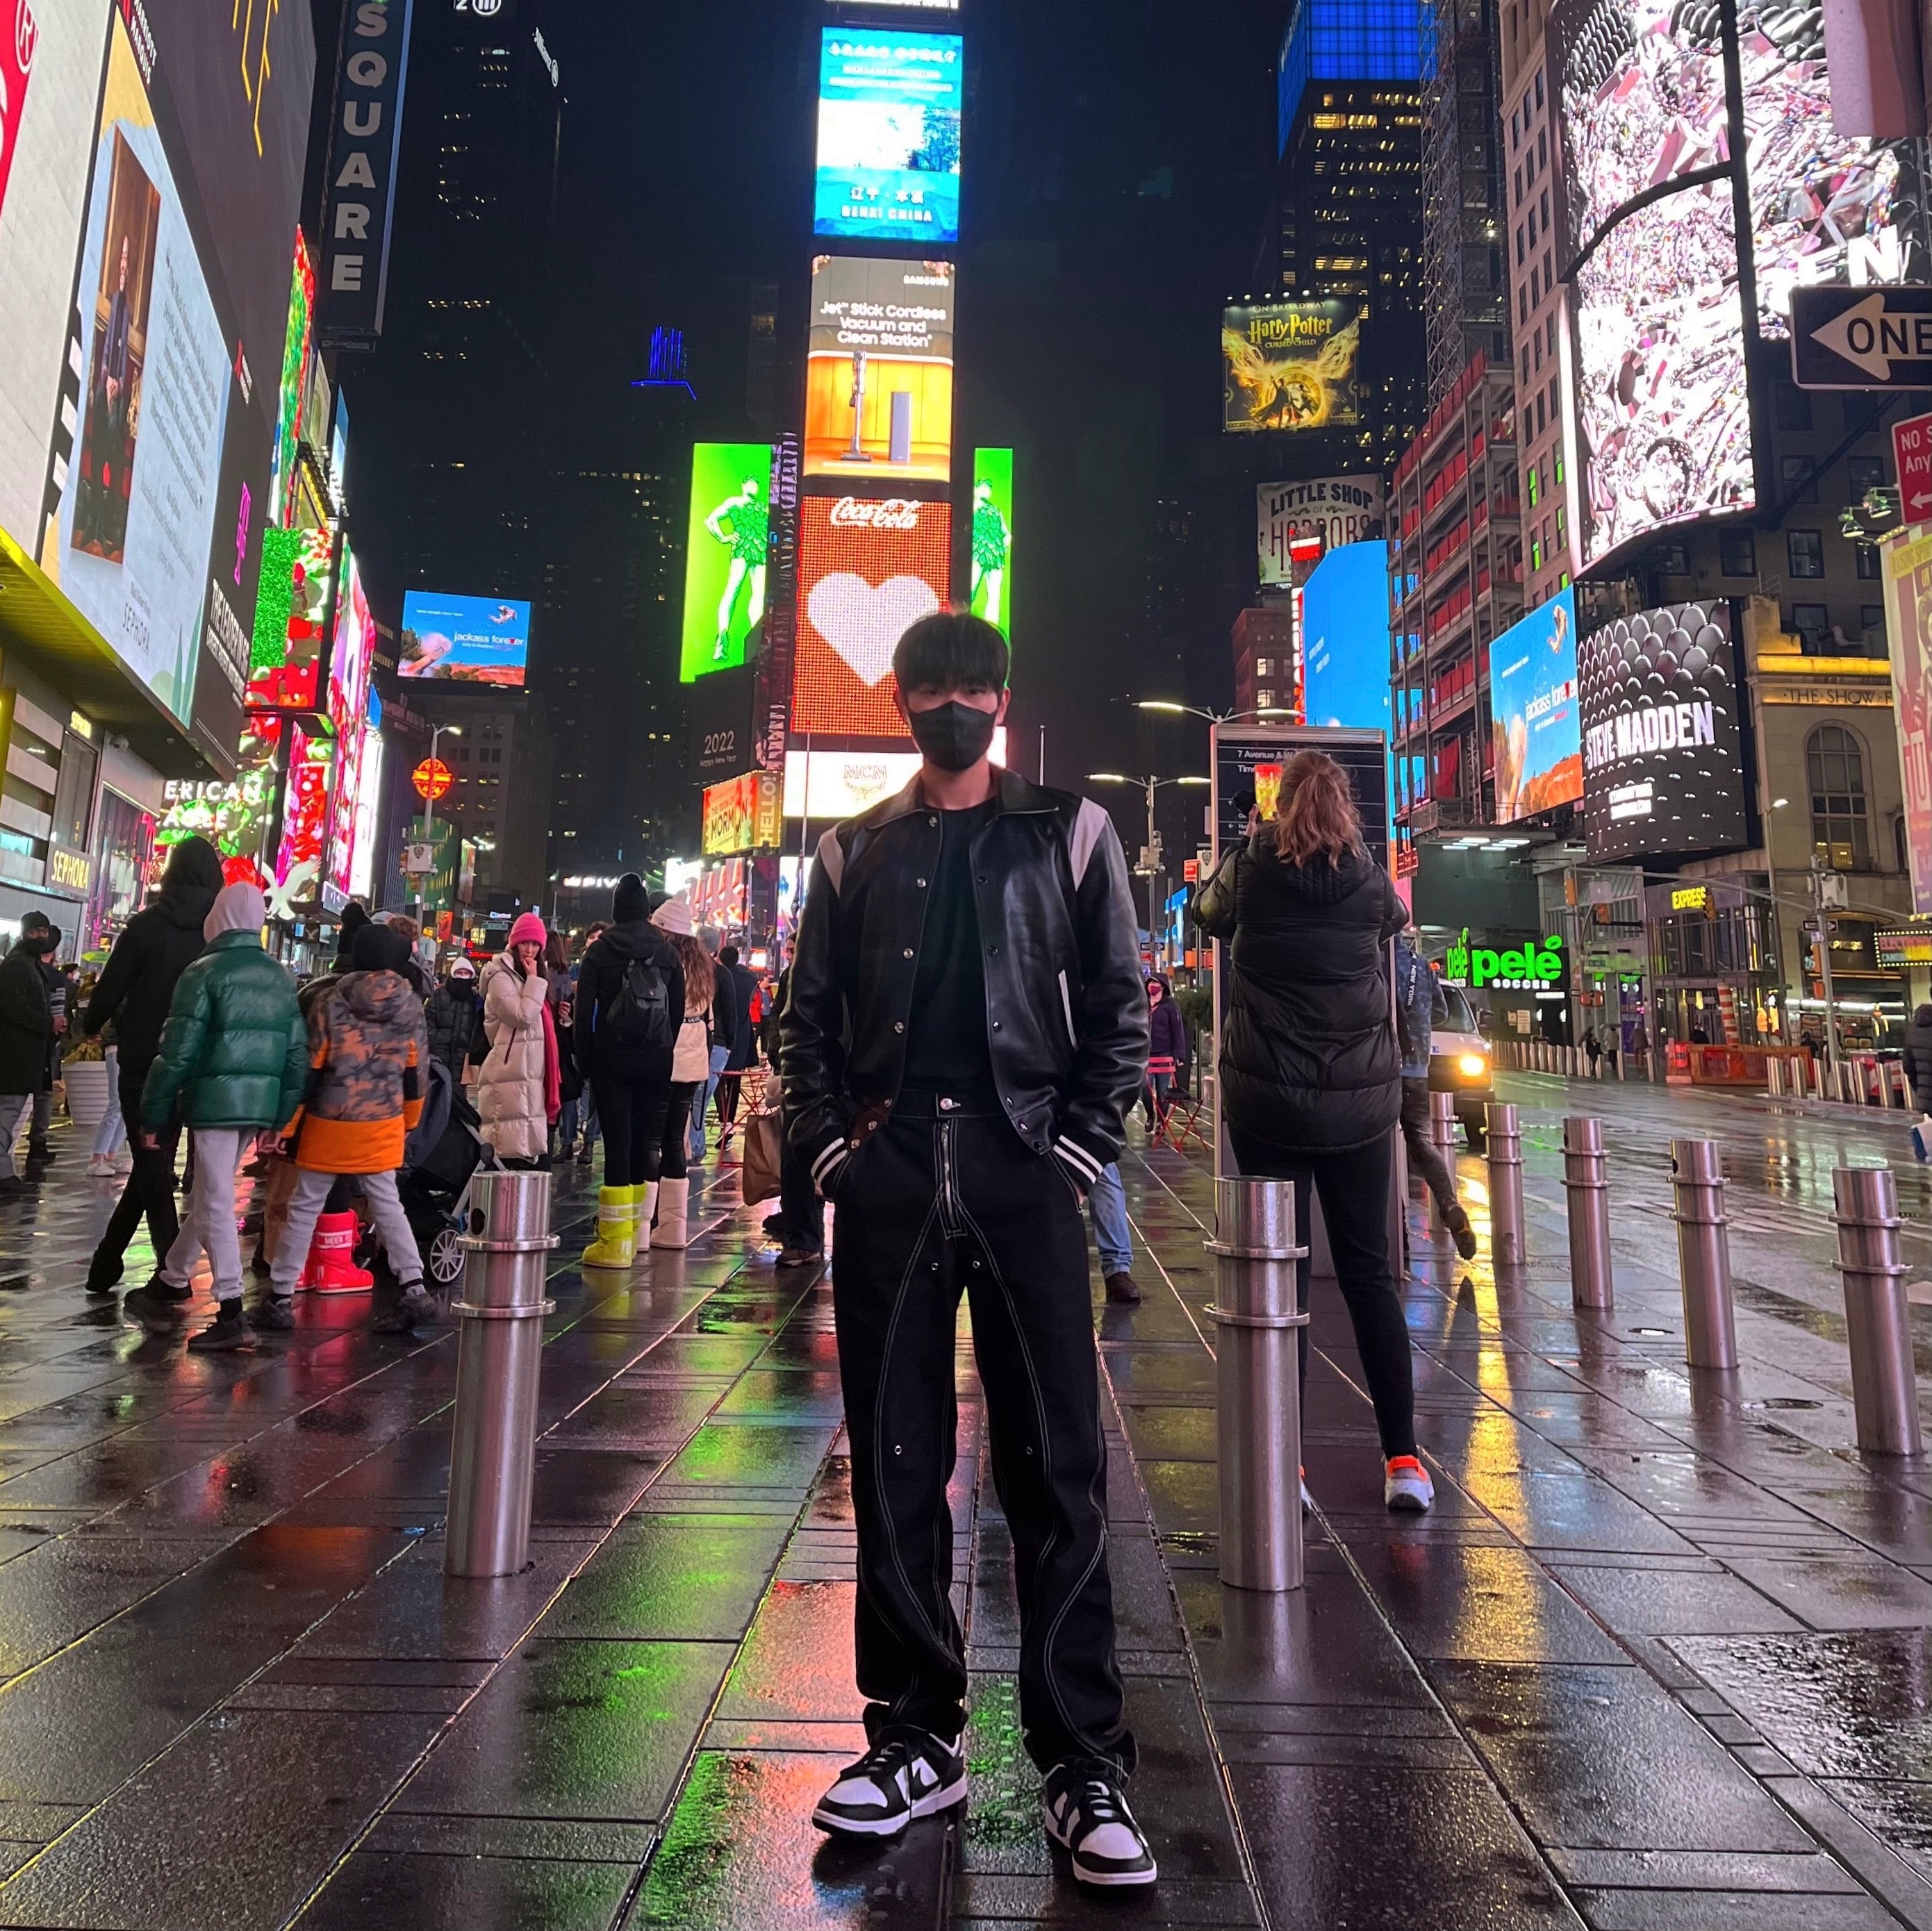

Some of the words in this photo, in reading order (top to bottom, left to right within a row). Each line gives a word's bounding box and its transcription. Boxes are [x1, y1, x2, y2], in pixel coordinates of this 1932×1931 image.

[331, 3, 388, 292] SQUARE
[888, 208, 932, 222] CHINA
[903, 275, 949, 286] SAMSUNG
[850, 301, 884, 317] Stick
[885, 304, 947, 320] Cordless
[839, 316, 896, 331] Vacuum
[898, 320, 927, 333] and
[1247, 319, 1289, 345] Harry
[1289, 313, 1333, 345] Potter
[836, 330, 879, 345] Clean
[1847, 317, 1932, 355] ONE
[1901, 429, 1921, 451] NO
[1271, 483, 1326, 517] LITTLE
[1331, 483, 1373, 510] SHOP
[122, 602, 151, 656] SEPHORA
[454, 631, 489, 644] jackass
[1790, 689, 1819, 703] THE
[1826, 690, 1875, 704] SHOW
[1526, 693, 1551, 729] jackass
[704, 731, 734, 755] 2022
[1585, 720, 1615, 770] STEVE
[1615, 701, 1715, 757] MADDEN
[1244, 750, 1275, 759] Avenue
[843, 764, 887, 779] MCM
[164, 781, 264, 800] ERICAN
[759, 776, 777, 843] HELLO!
[51, 850, 90, 890] SEPHORA
[582, 877, 618, 888] PIV
[1672, 886, 1706, 910] EXPRESS
[1471, 934, 1562, 987] pelé
[1492, 978, 1551, 989] SOCCER
[1407, 986, 1415, 1006] YORK
